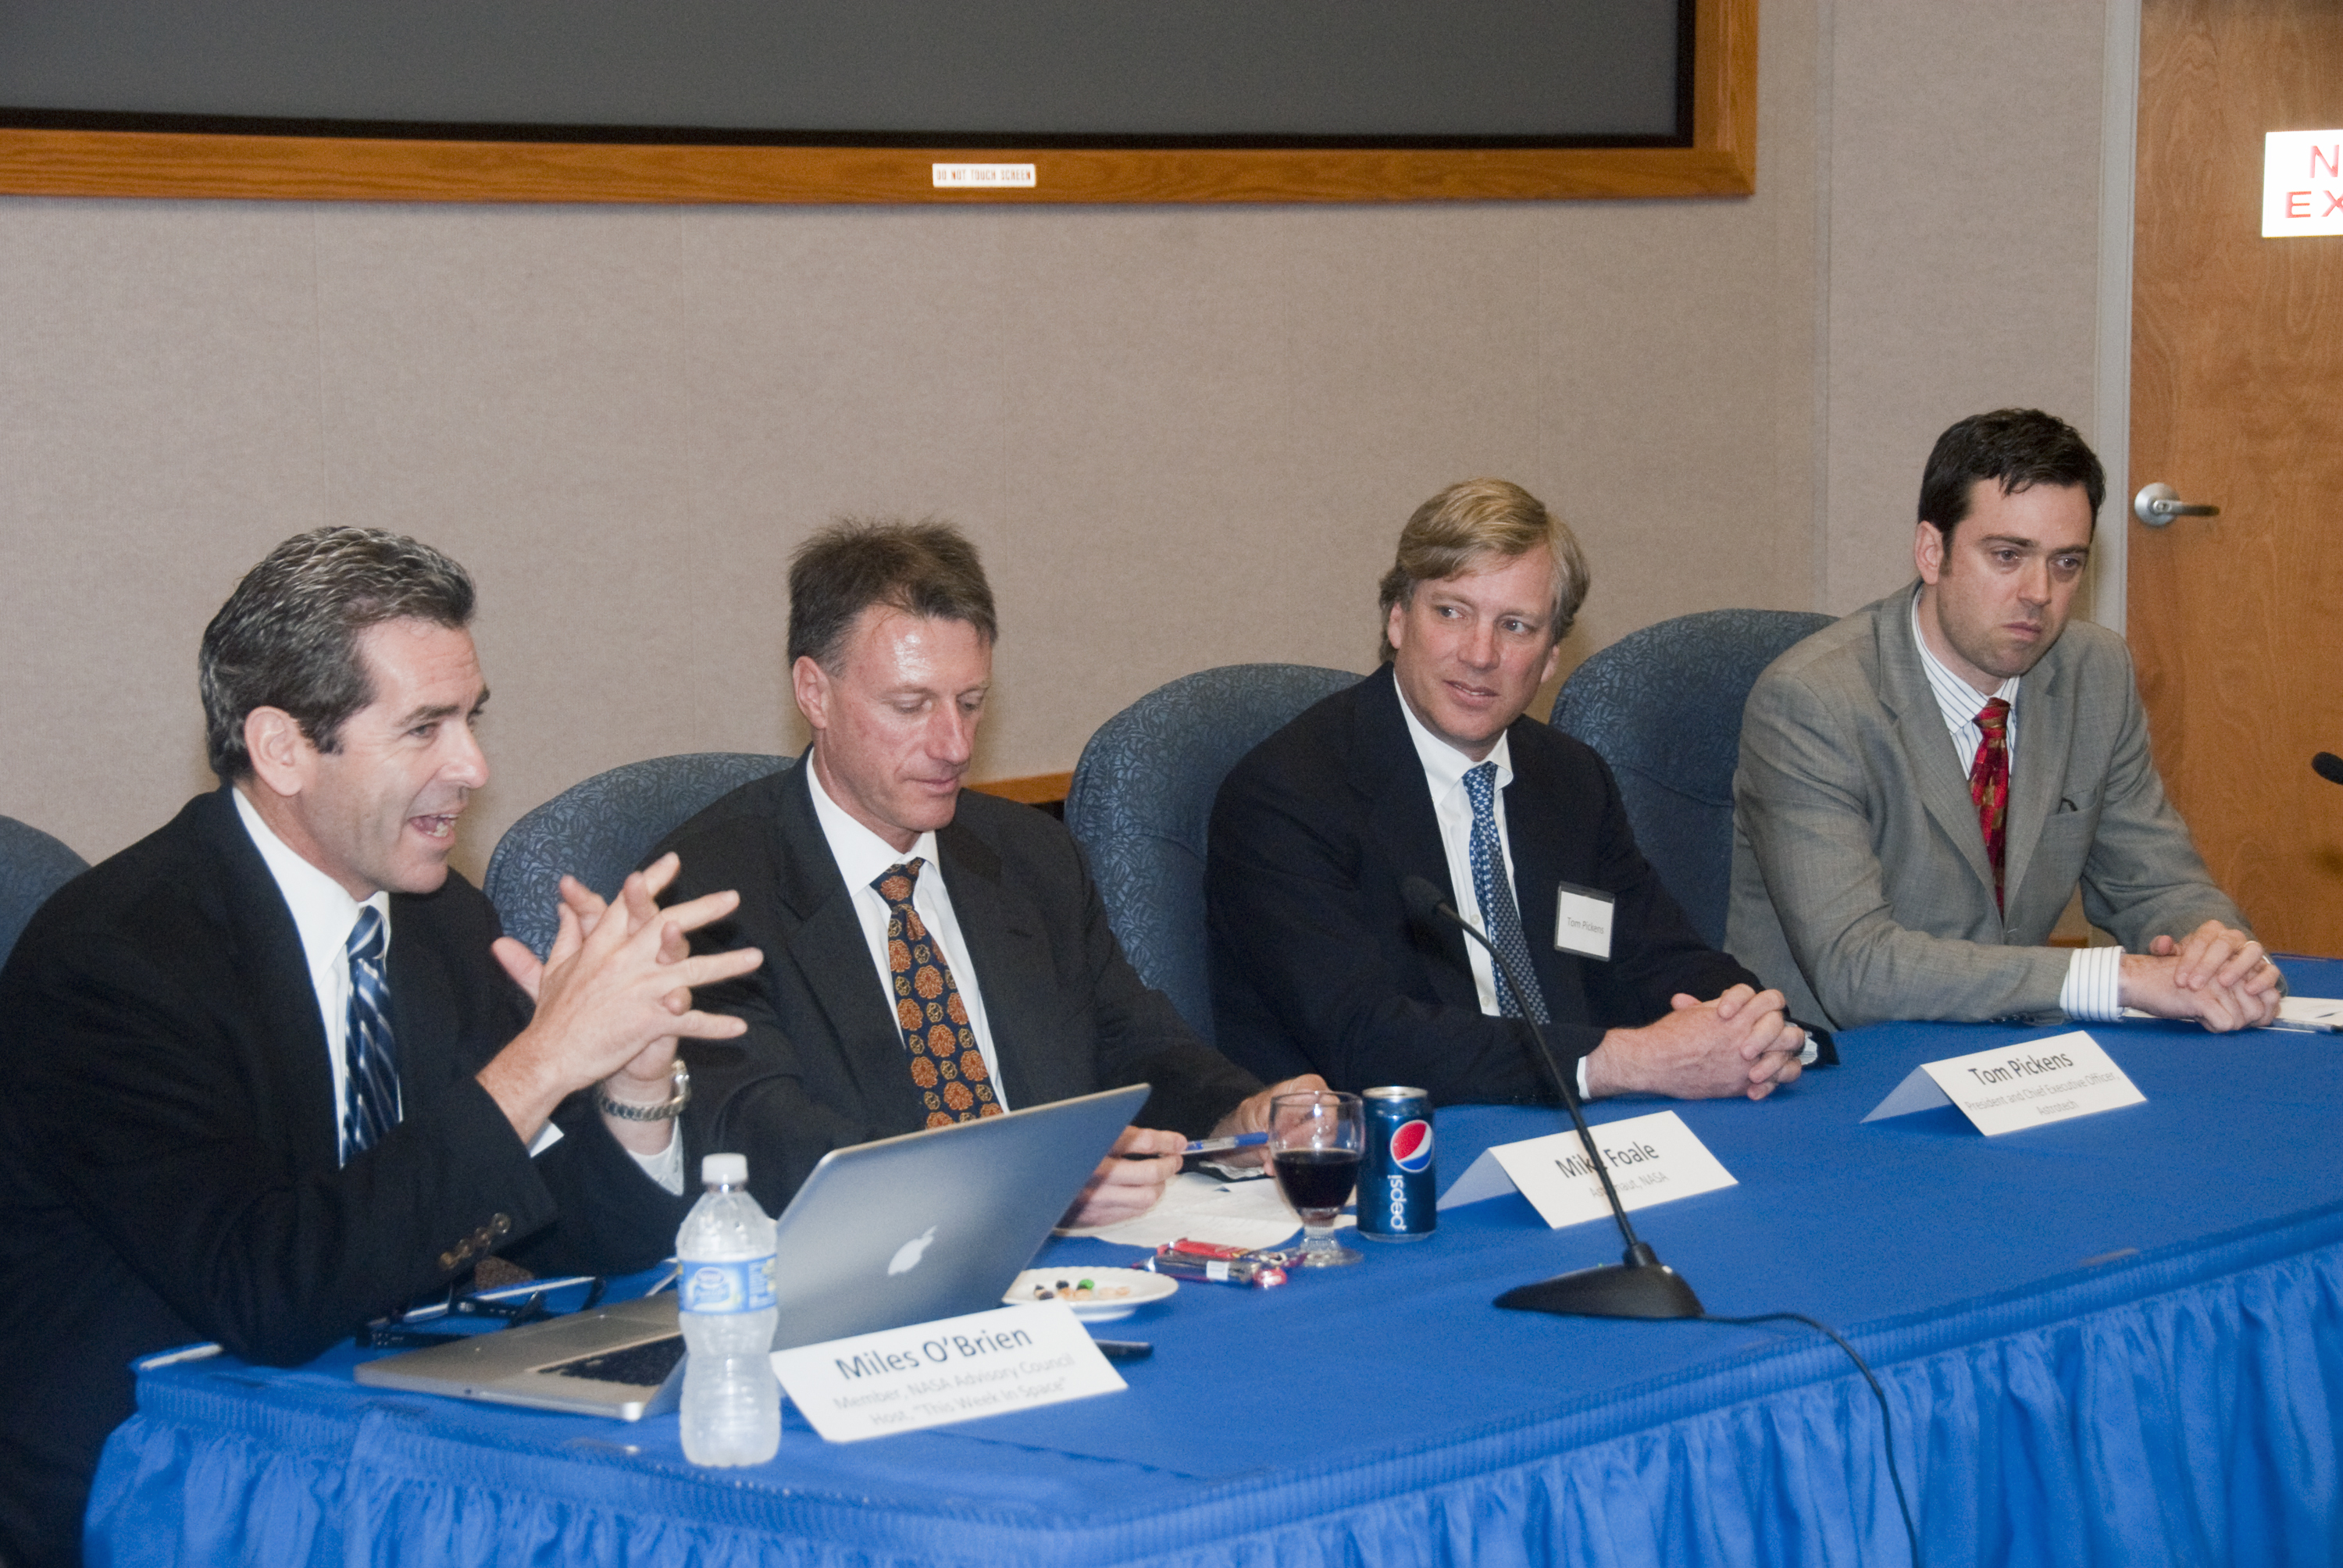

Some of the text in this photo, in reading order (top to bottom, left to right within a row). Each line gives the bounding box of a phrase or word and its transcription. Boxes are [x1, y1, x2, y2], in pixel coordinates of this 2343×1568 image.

[937, 169, 1031, 180] DO NOT TOUCH SCREEN
[1567, 917, 1604, 934] Tom Pickens
[1967, 1053, 2074, 1085] Tom Pickens
[1964, 1071, 2121, 1112] President and Chief Executive Officer,
[2037, 1099, 2079, 1116] Astrotech
[1554, 1142, 1659, 1178] Mik Foale
[1639, 1171, 1670, 1187] NASA
[1387, 1174, 1407, 1231] pepsi
[834, 1327, 1033, 1381] Miles O'Brien
[833, 1352, 1076, 1410] Member, NASA Advisory Council
[869, 1377, 1068, 1426] Host, "This Week In Space"
